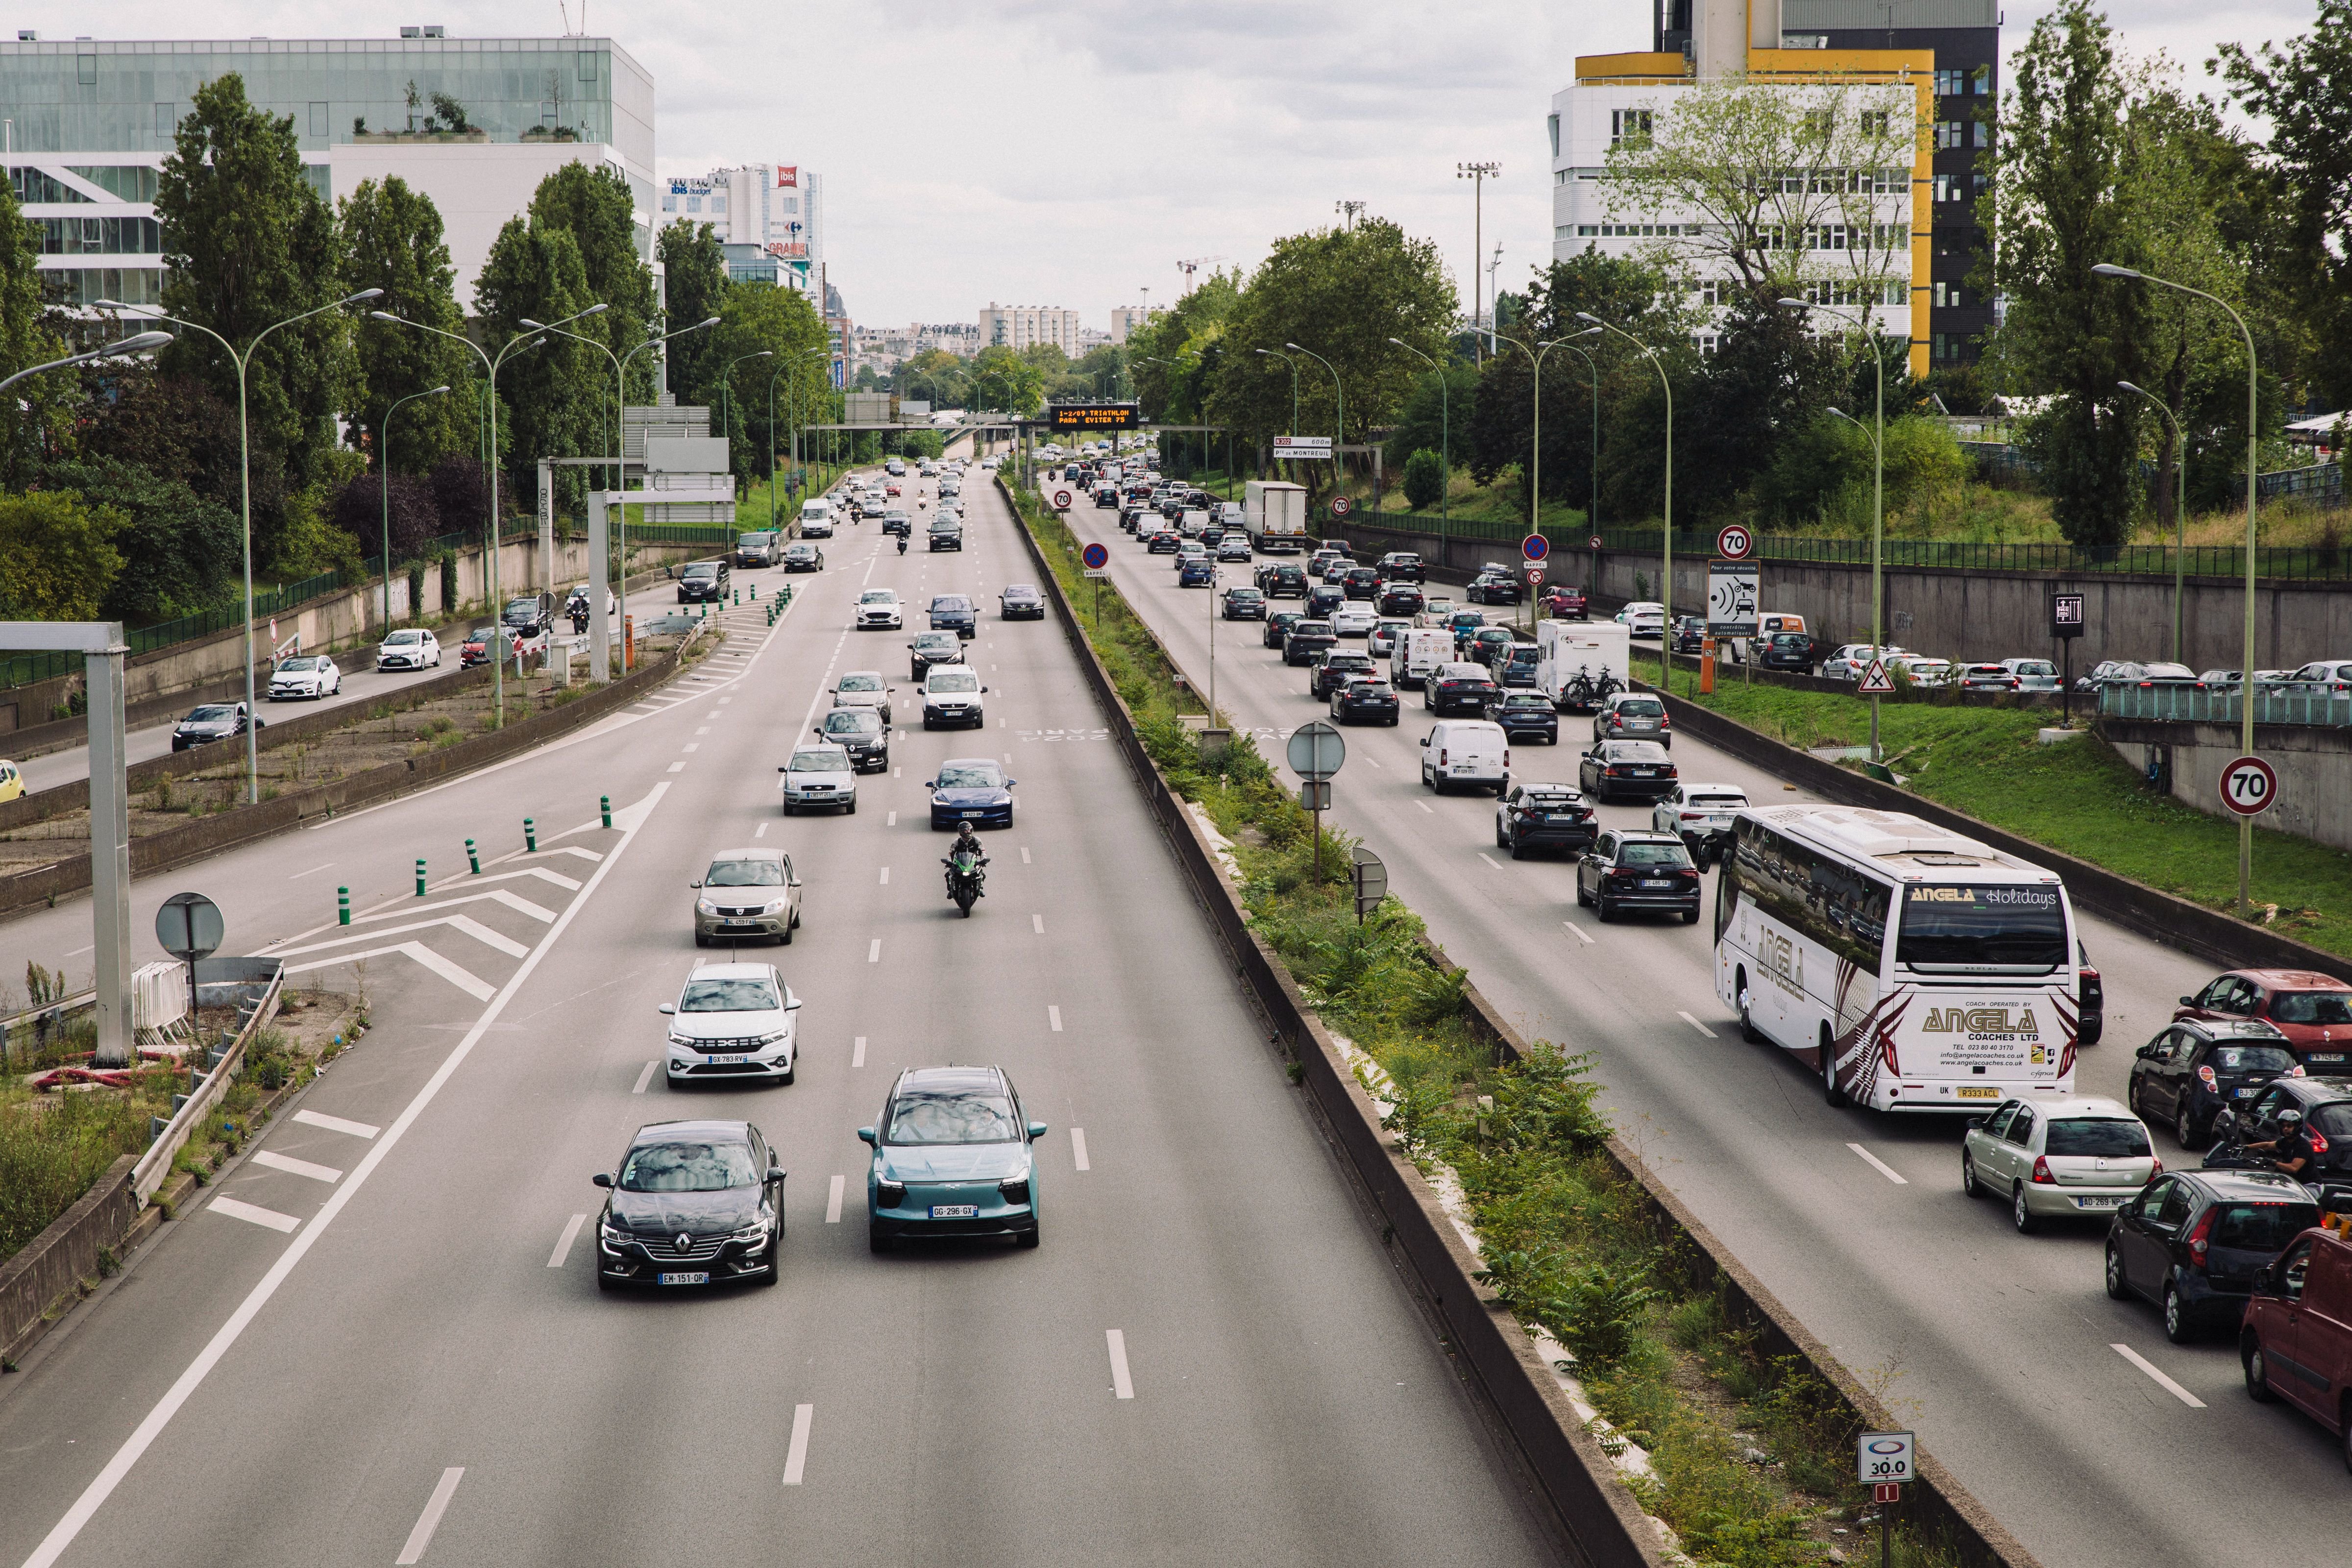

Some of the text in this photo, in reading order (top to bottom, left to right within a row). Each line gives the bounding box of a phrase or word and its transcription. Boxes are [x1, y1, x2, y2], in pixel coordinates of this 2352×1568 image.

[780, 172, 795, 181] ibis
[671, 184, 711, 196] ibis budget
[768, 243, 806, 254] GRANDE
[1726, 535, 1744, 549] 70
[2232, 774, 2265, 798] 70
[1911, 887, 2057, 910] ANGELA Holidays
[1757, 925, 1805, 1002] ANGELA
[1922, 1008, 2039, 1033] ANGELA
[1871, 1460, 1906, 1475] 30.0
